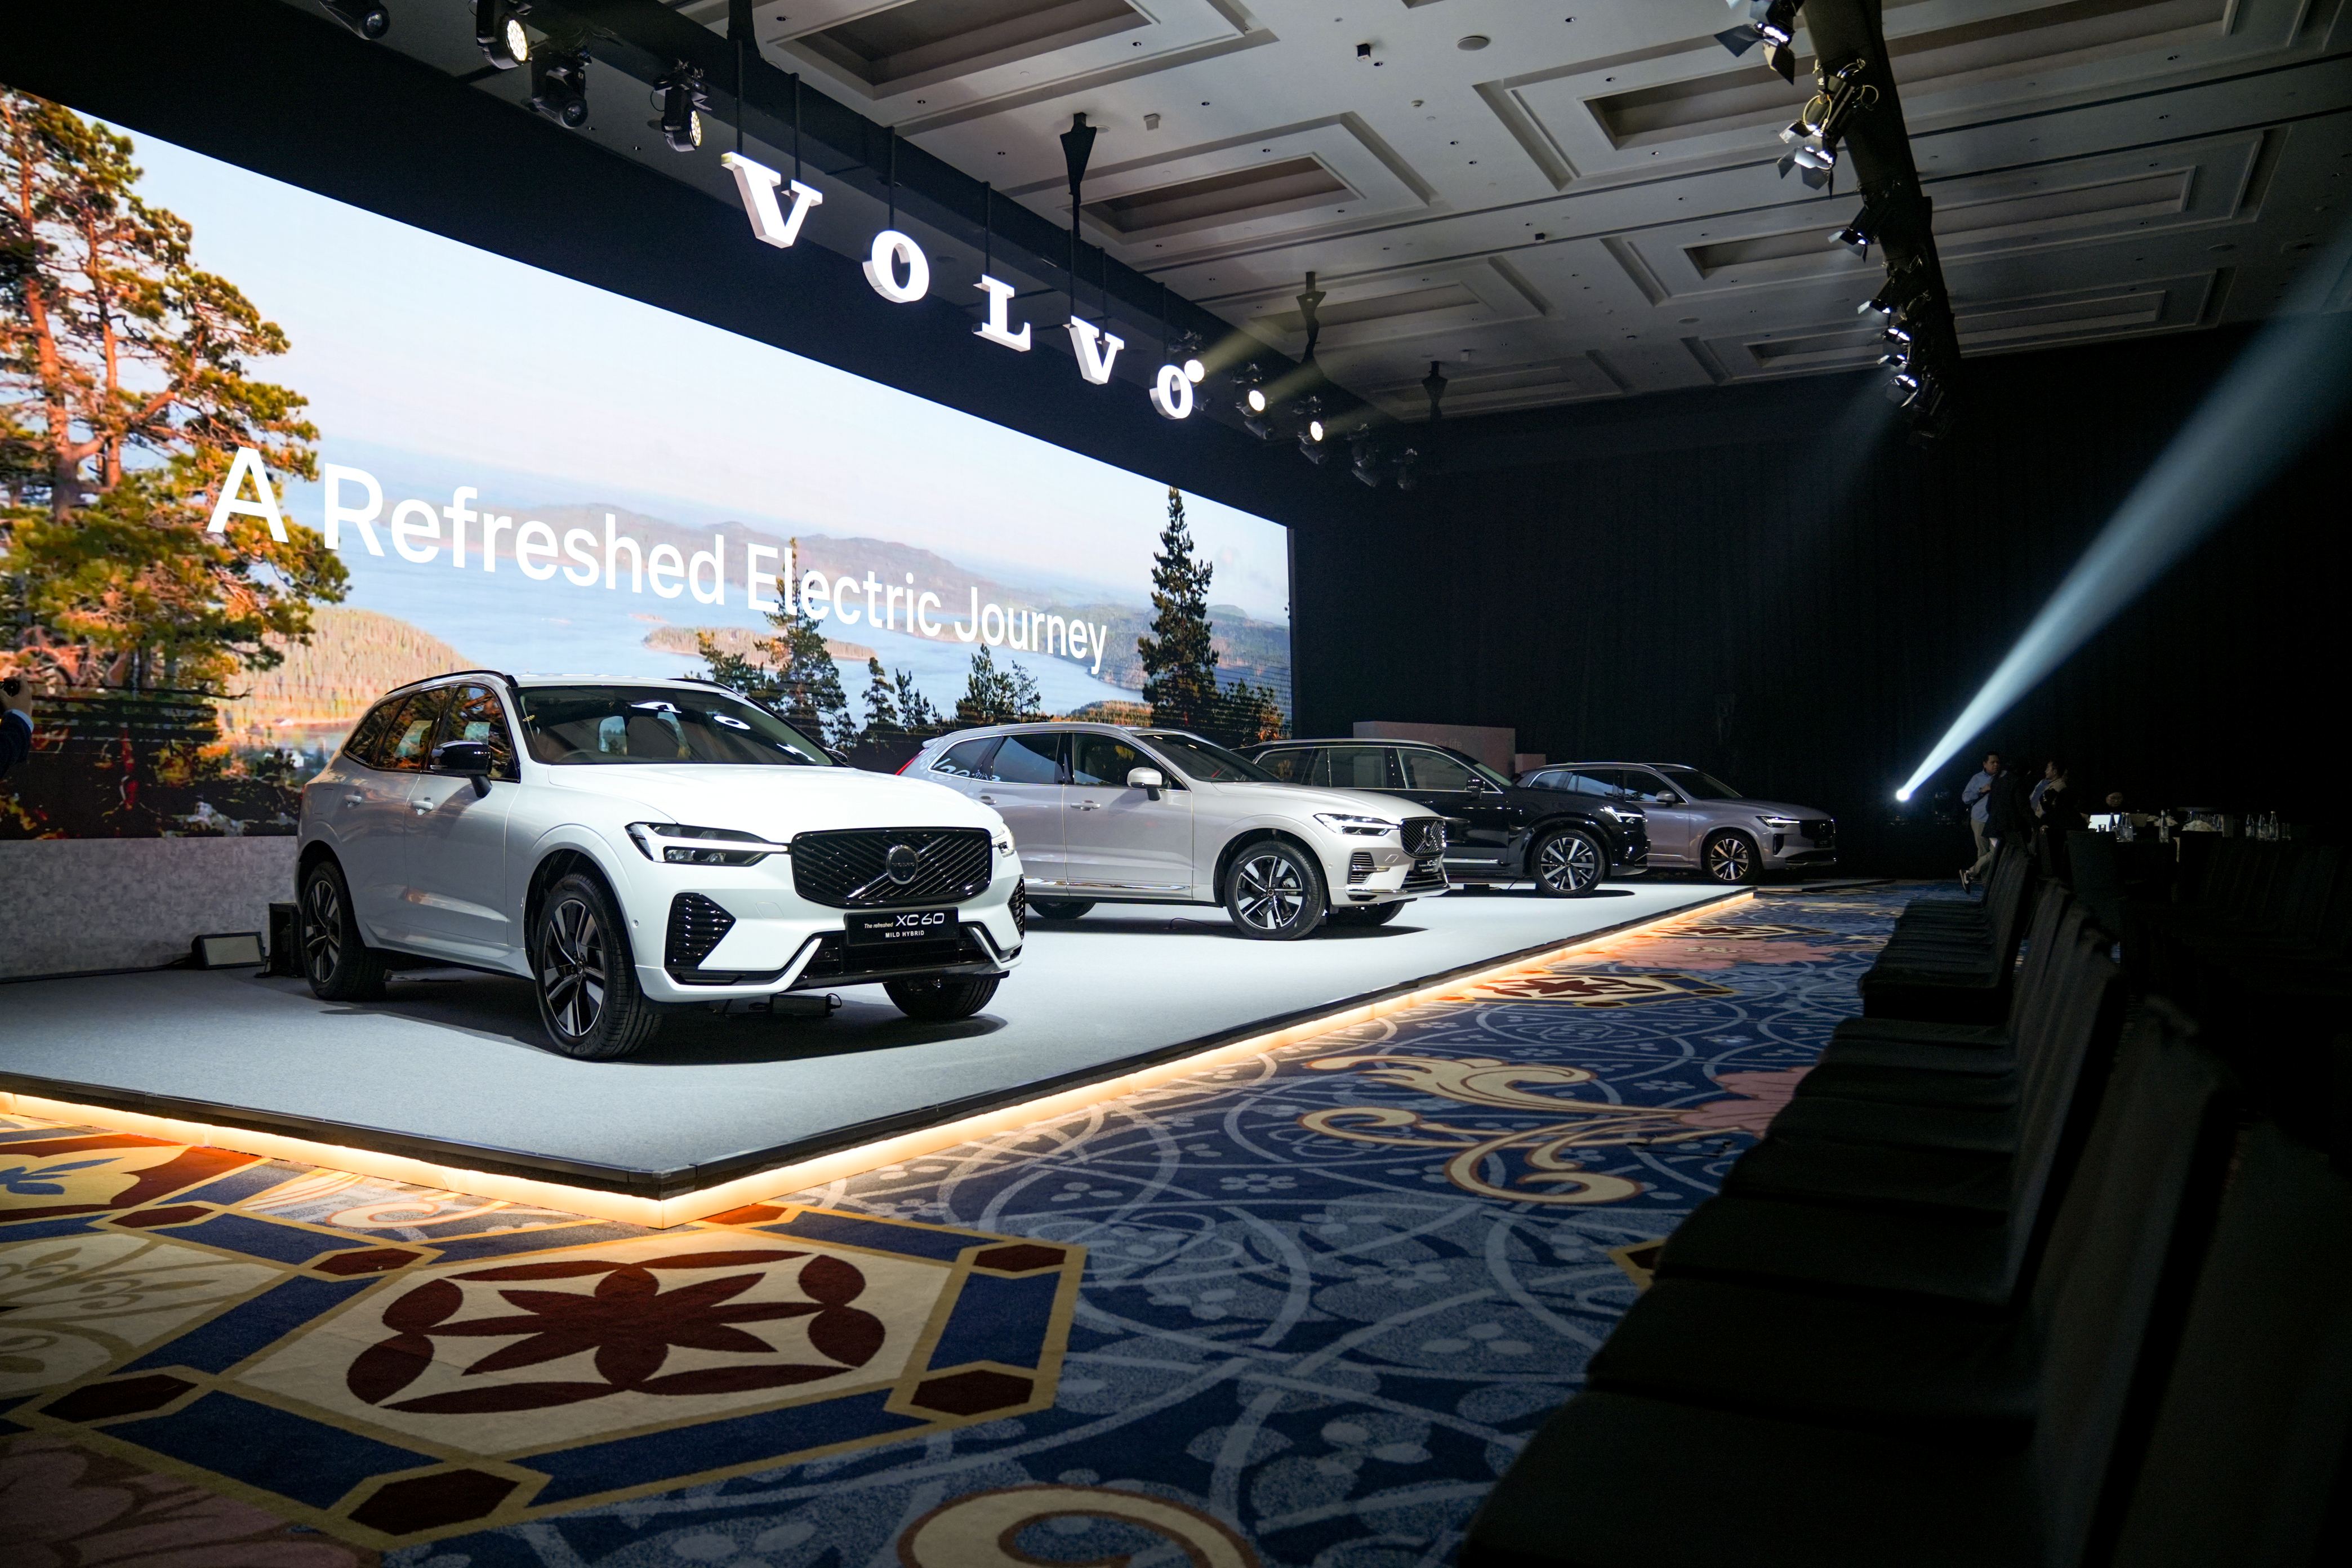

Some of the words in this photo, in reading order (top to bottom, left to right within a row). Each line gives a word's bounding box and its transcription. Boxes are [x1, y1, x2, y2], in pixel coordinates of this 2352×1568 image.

[721, 152, 1193, 419] VOLVO
[207, 446, 289, 543] A
[324, 462, 725, 606] Refreshed
[747, 542, 943, 638] Electric
[954, 586, 1107, 674] Journey
